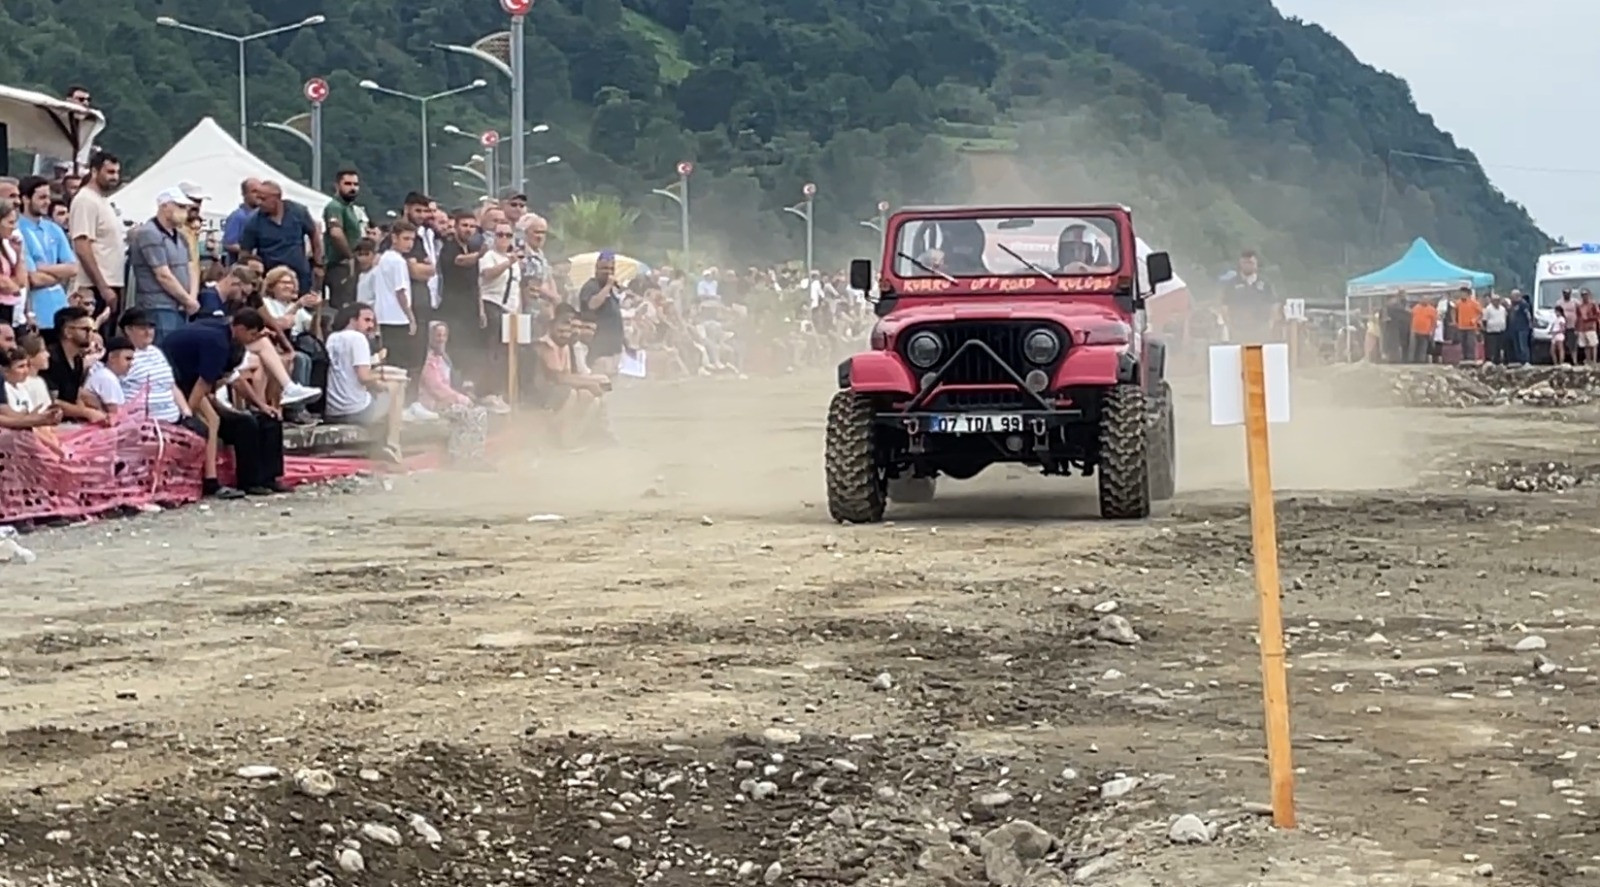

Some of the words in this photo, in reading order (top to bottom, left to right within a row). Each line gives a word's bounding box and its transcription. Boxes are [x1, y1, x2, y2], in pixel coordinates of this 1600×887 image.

[999, 277, 1036, 292] ROAD
[939, 417, 957, 432] 07
[1000, 417, 1020, 432] 99
